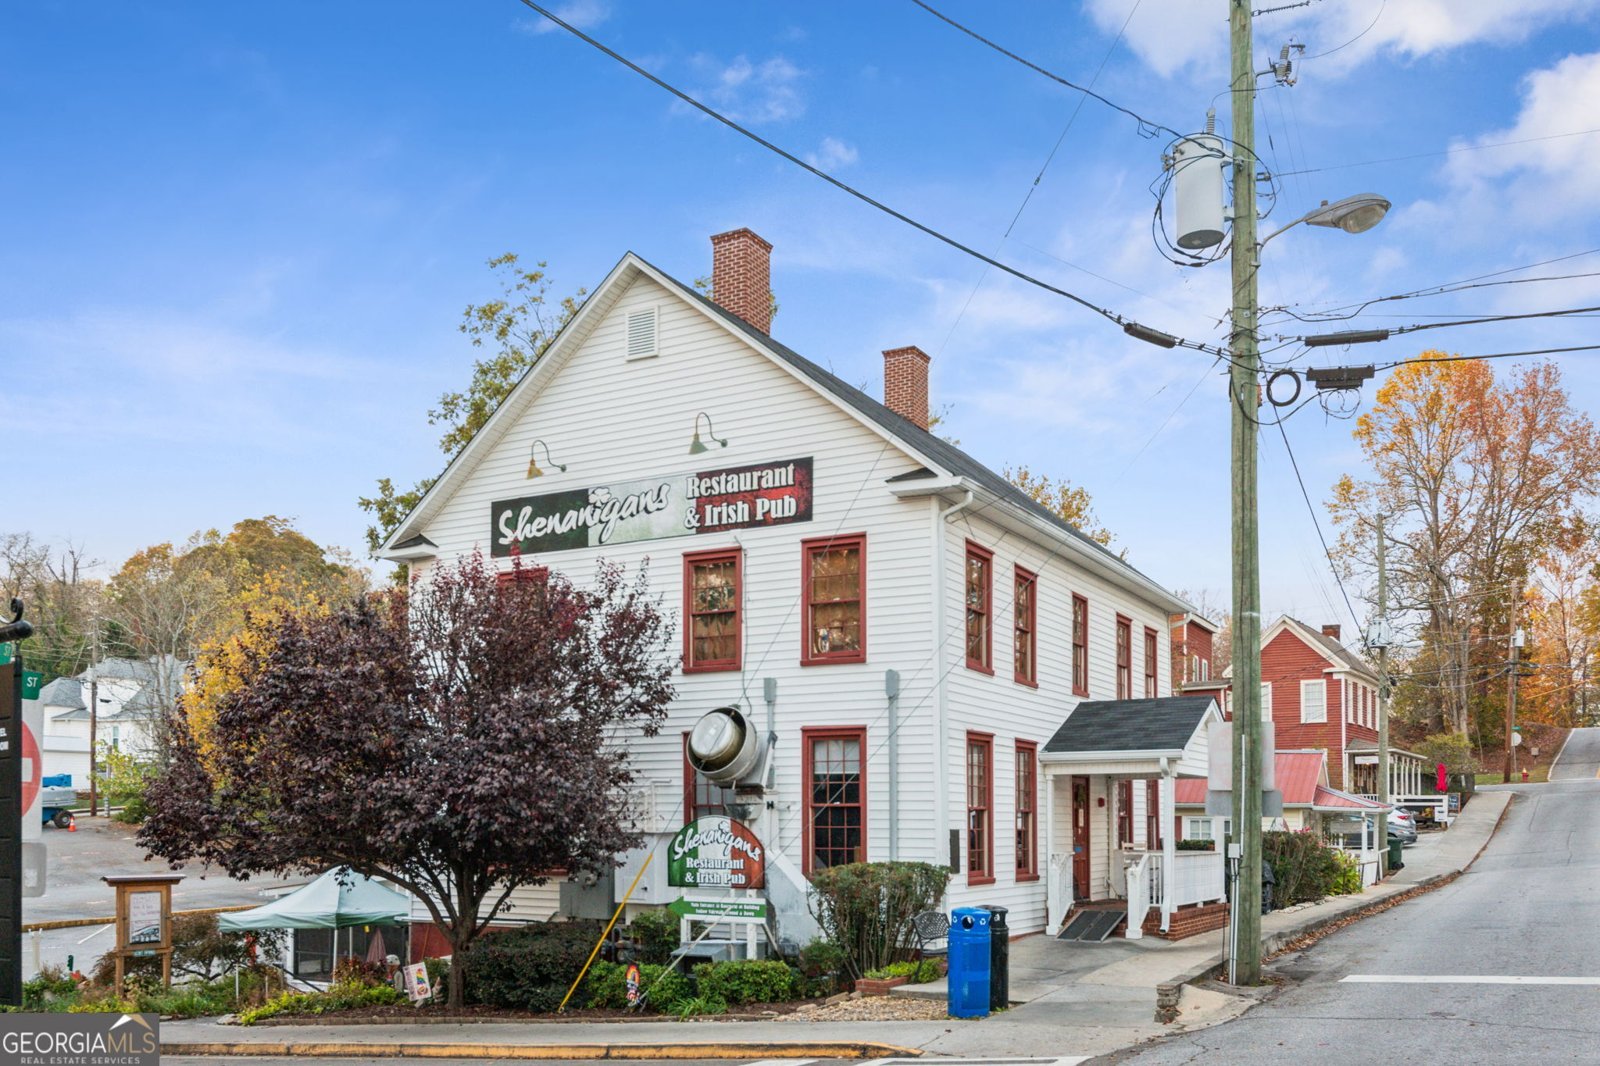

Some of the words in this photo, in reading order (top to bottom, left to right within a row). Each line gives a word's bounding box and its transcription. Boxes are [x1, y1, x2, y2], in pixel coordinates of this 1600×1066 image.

[685, 462, 795, 500] Restaurant
[498, 482, 671, 544] Shenanigans
[684, 506, 701, 530] &
[704, 500, 750, 527] Irish
[755, 494, 797, 520] Pub
[27, 676, 38, 688] ST
[673, 821, 761, 861] Shenanigans
[685, 872, 694, 883] &
[696, 872, 721, 884] Irish
[724, 873, 746, 884] Pub
[686, 857, 744, 870] Restaurant
